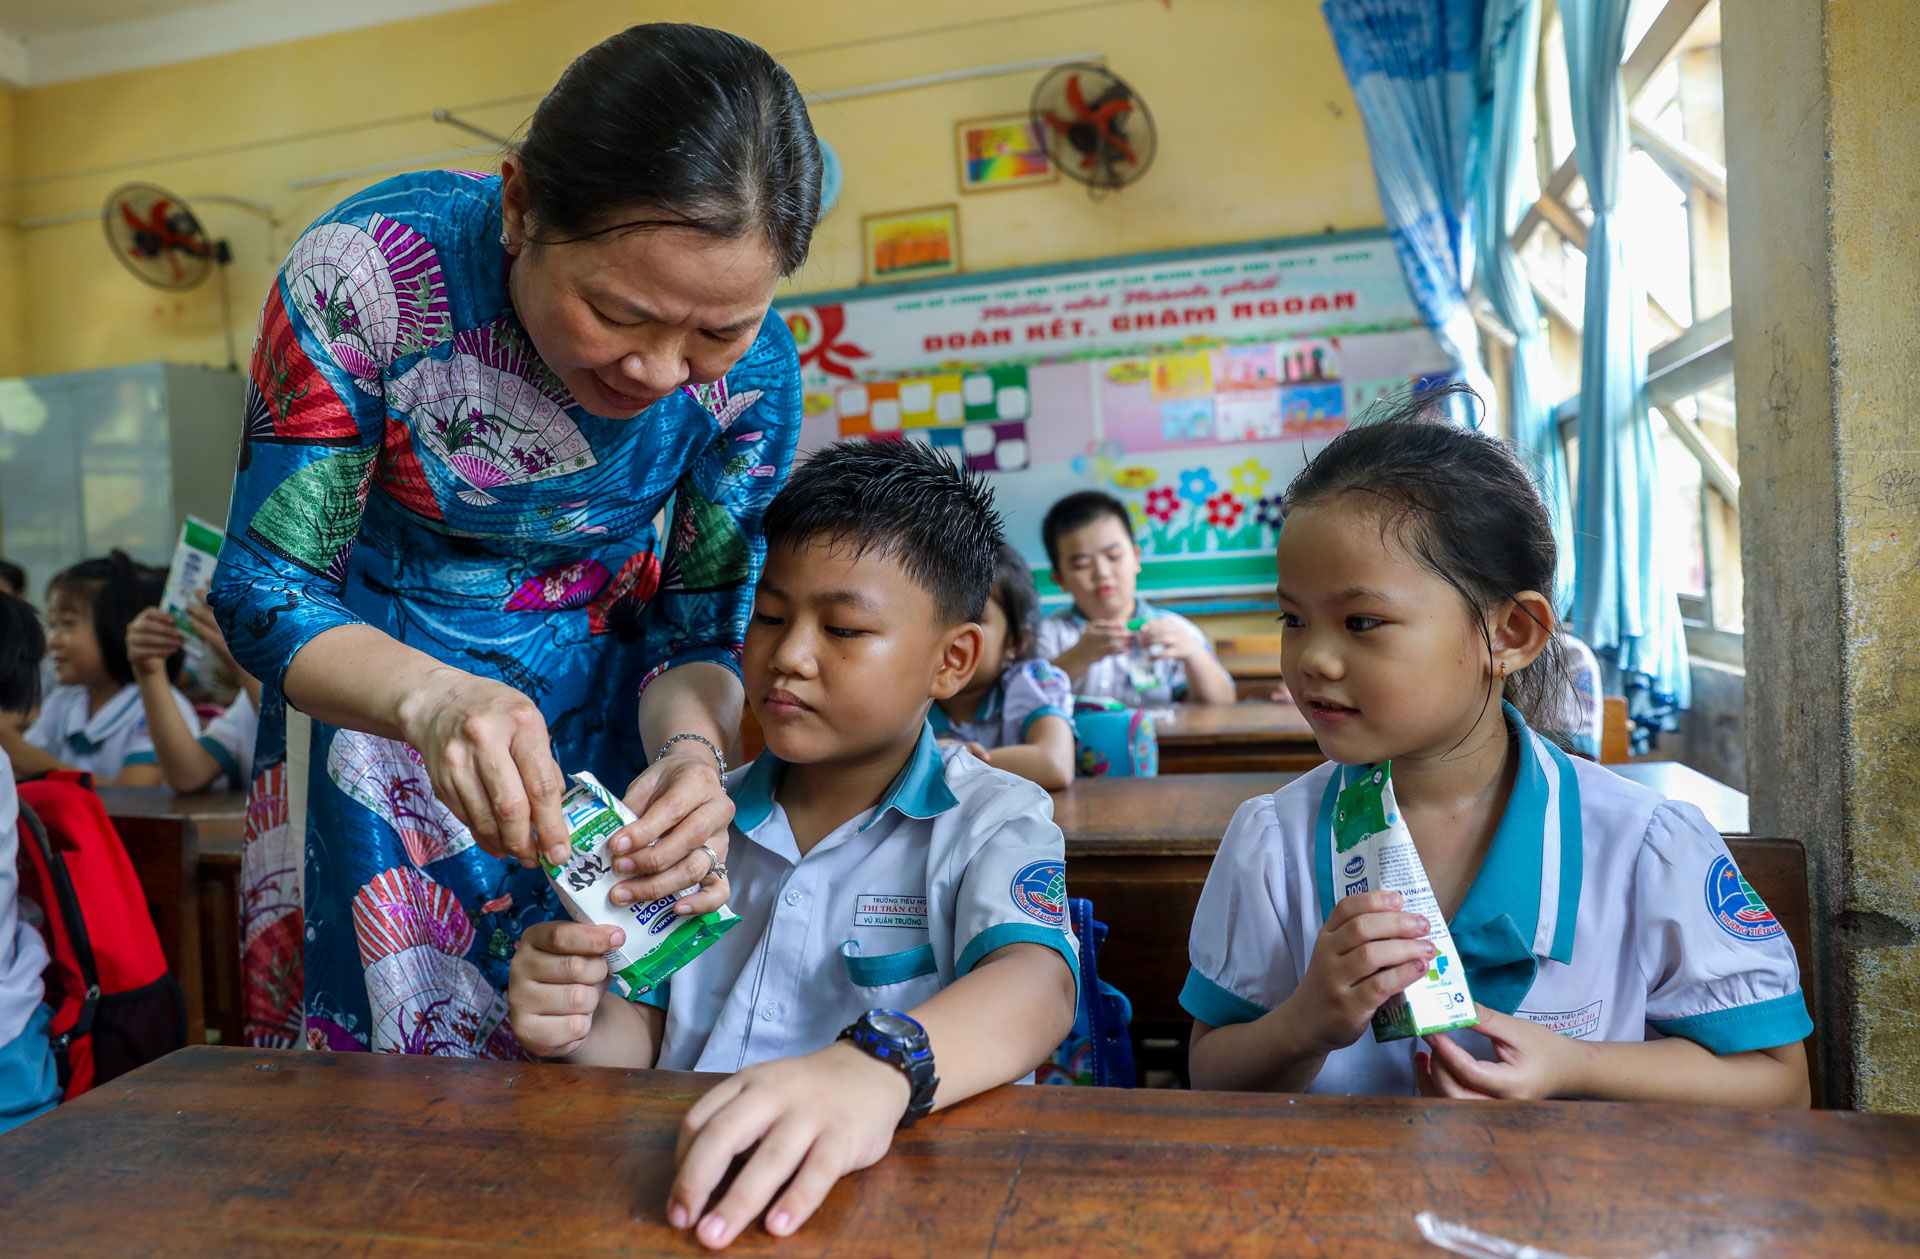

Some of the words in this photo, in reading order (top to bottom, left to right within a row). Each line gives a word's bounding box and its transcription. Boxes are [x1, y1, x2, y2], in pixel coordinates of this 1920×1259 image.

[923, 328, 1012, 352] ĐOÀN
[1231, 292, 1356, 321] NGOAN
[1346, 879, 1368, 896] 100%
[639, 895, 674, 923] 100%
[863, 904, 878, 912] THỊ
[881, 903, 905, 913] TRẤN
[652, 911, 677, 933] NAMILK
[864, 915, 873, 924] VŨ
[875, 916, 893, 925] XUÂN
[895, 917, 922, 926] TRƯỜNG
[1545, 1021, 1565, 1029] RẤN
